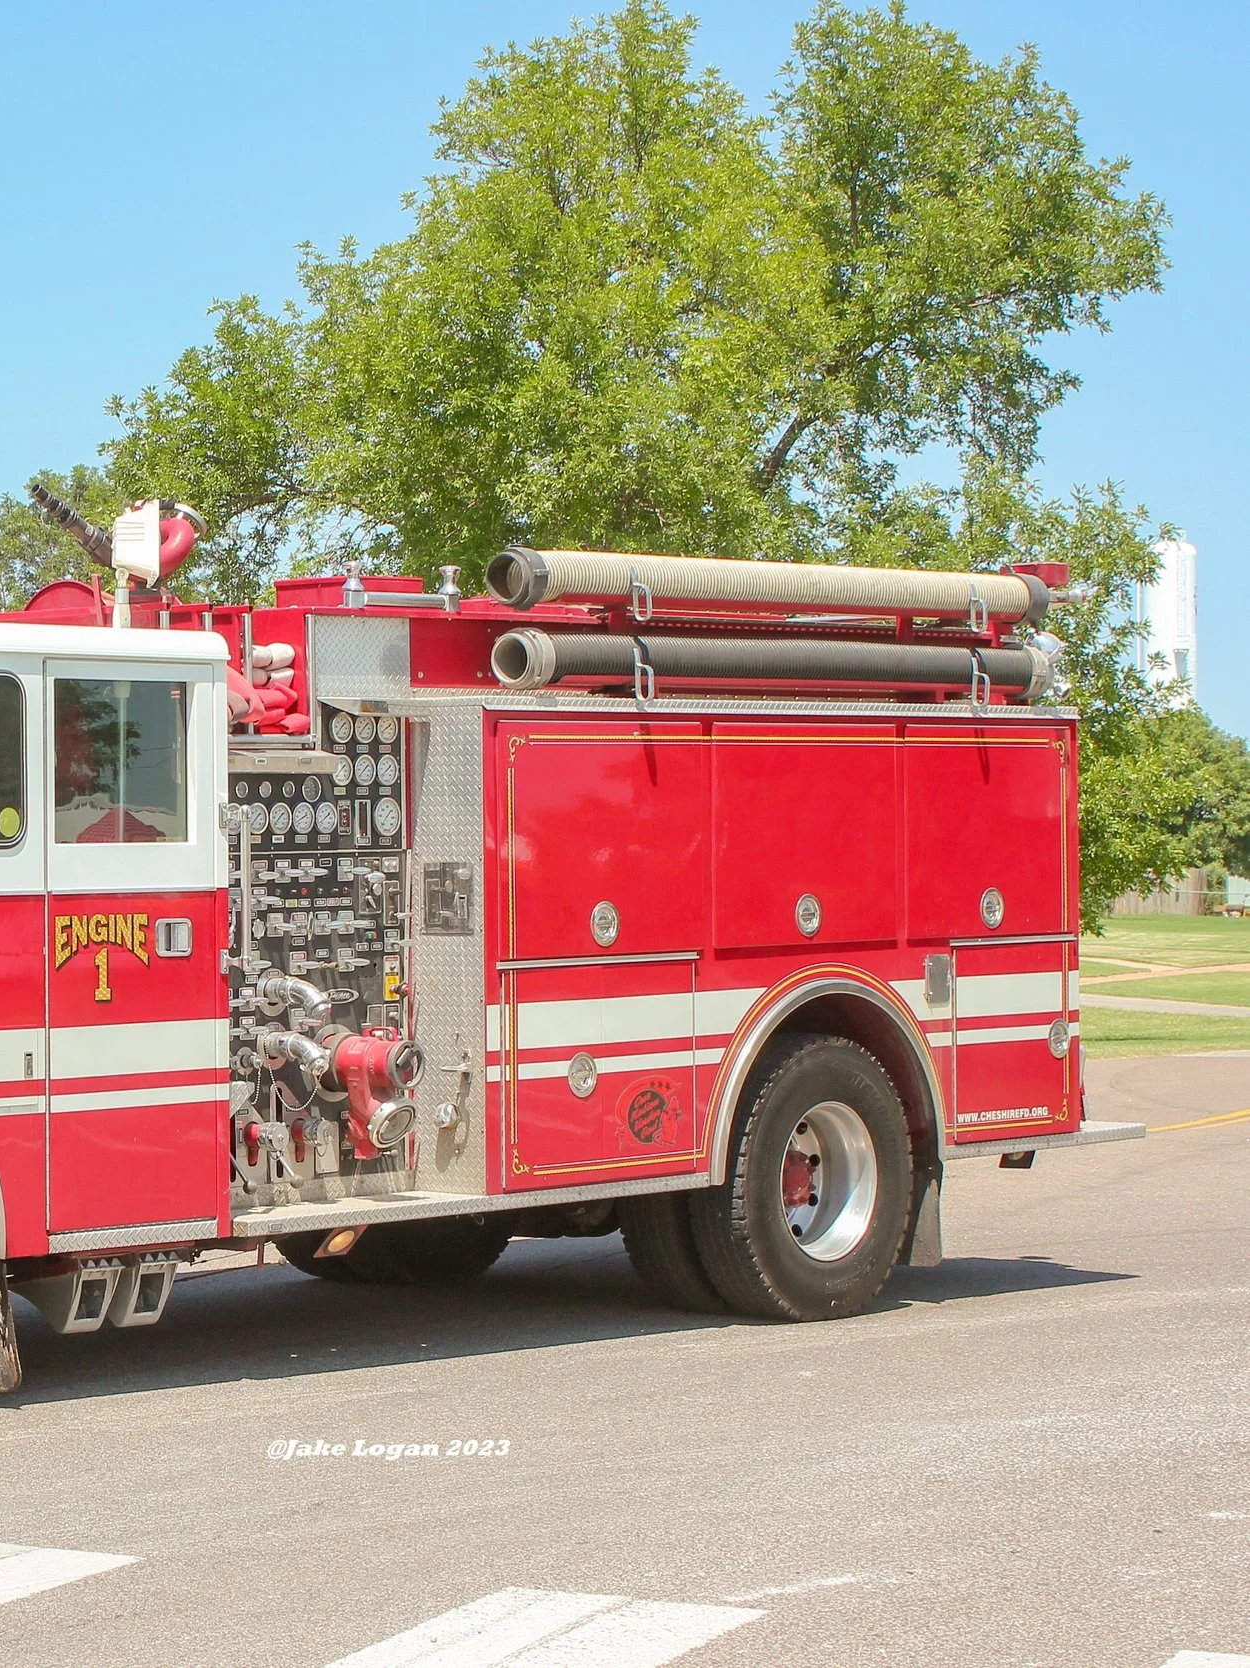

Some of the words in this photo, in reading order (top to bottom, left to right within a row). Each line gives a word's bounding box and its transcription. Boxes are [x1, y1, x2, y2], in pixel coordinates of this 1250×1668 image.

[54, 913, 150, 973] ENGINE
[94, 947, 112, 1003] 1
[956, 1106, 1049, 1123] WWW.CHESHIREFD.ORG
